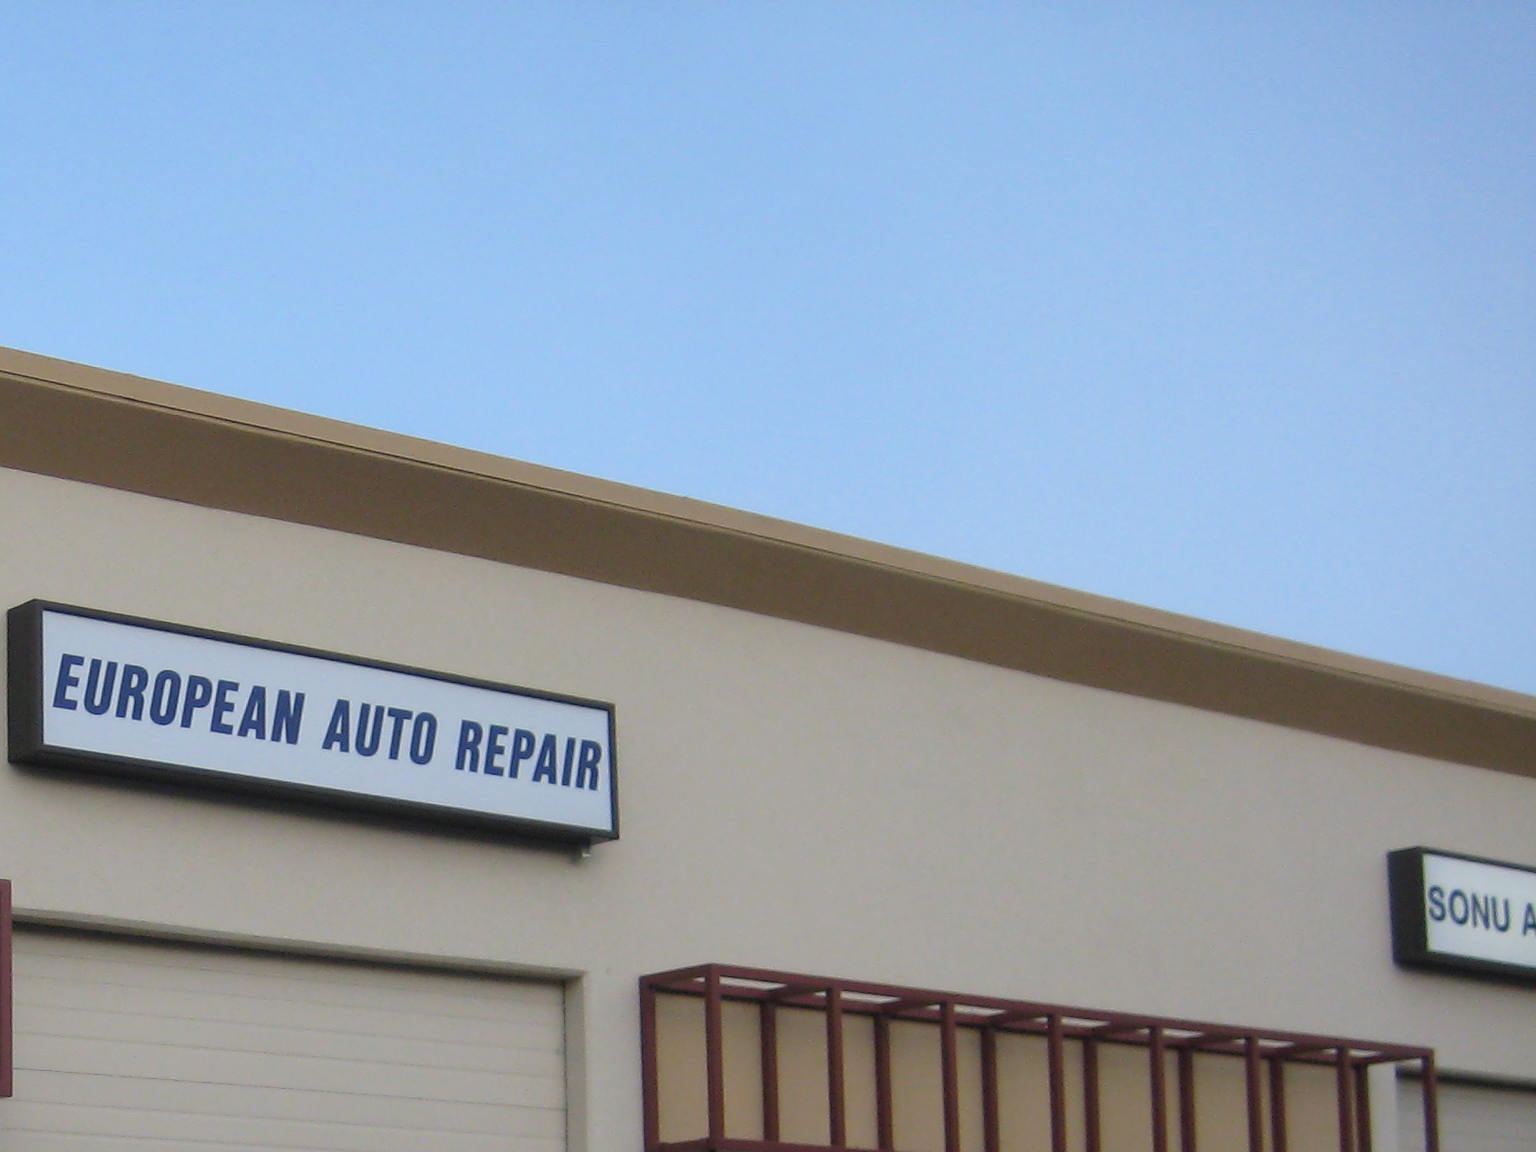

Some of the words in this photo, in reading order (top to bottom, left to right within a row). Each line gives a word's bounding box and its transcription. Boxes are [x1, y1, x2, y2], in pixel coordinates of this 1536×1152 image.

[52, 652, 306, 745] EUROPEAN
[322, 698, 438, 766] AUTO
[454, 718, 603, 792] REPAIR
[1427, 884, 1511, 933] SONU
